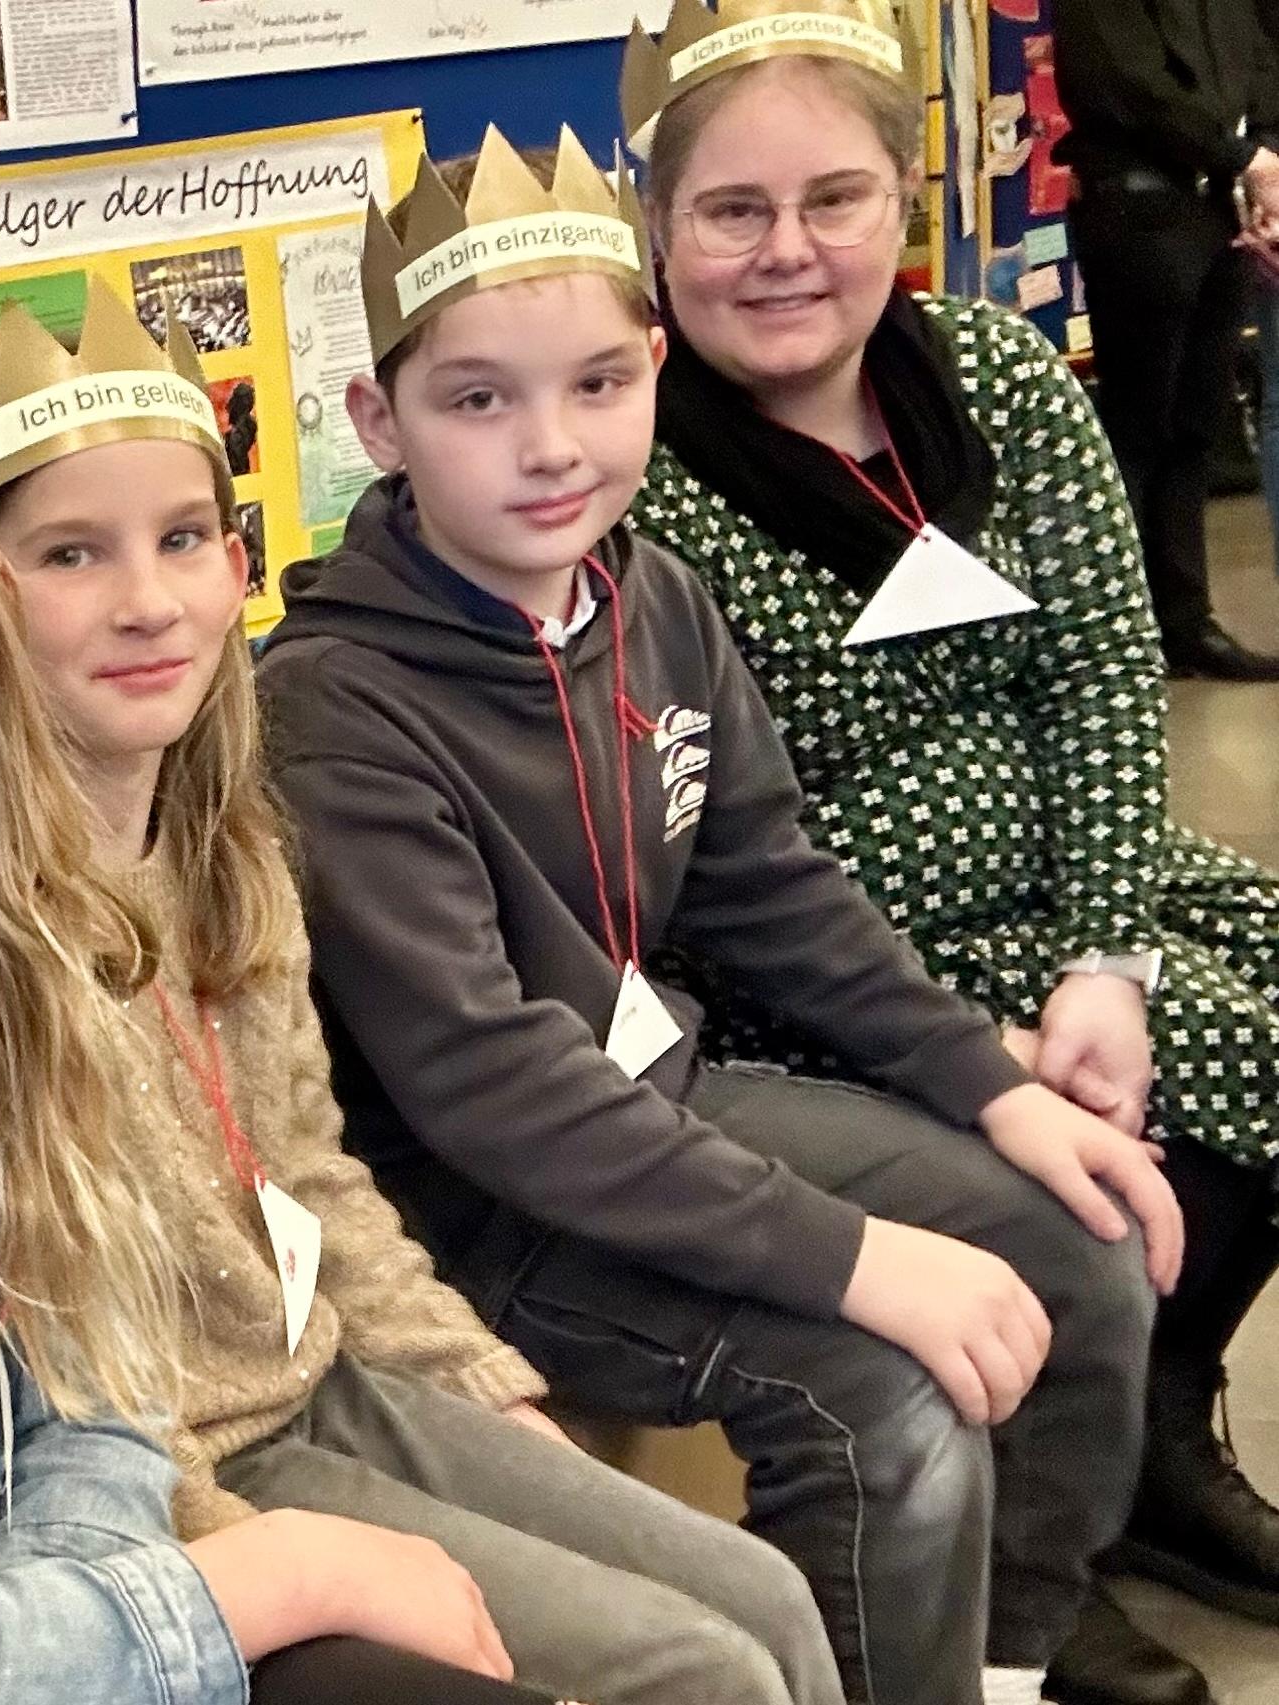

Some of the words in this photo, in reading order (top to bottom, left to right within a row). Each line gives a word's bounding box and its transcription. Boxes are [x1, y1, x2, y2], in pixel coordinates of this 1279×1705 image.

[692, 38, 724, 62] Ich
[728, 24, 764, 47] bin
[768, 19, 845, 38] Gottes
[103, 175, 174, 223] der
[180, 156, 369, 219] Hoffnung
[412, 258, 445, 291] Ich
[448, 240, 489, 270] bin
[19, 398, 68, 431] Ich
[73, 383, 125, 411] bin
